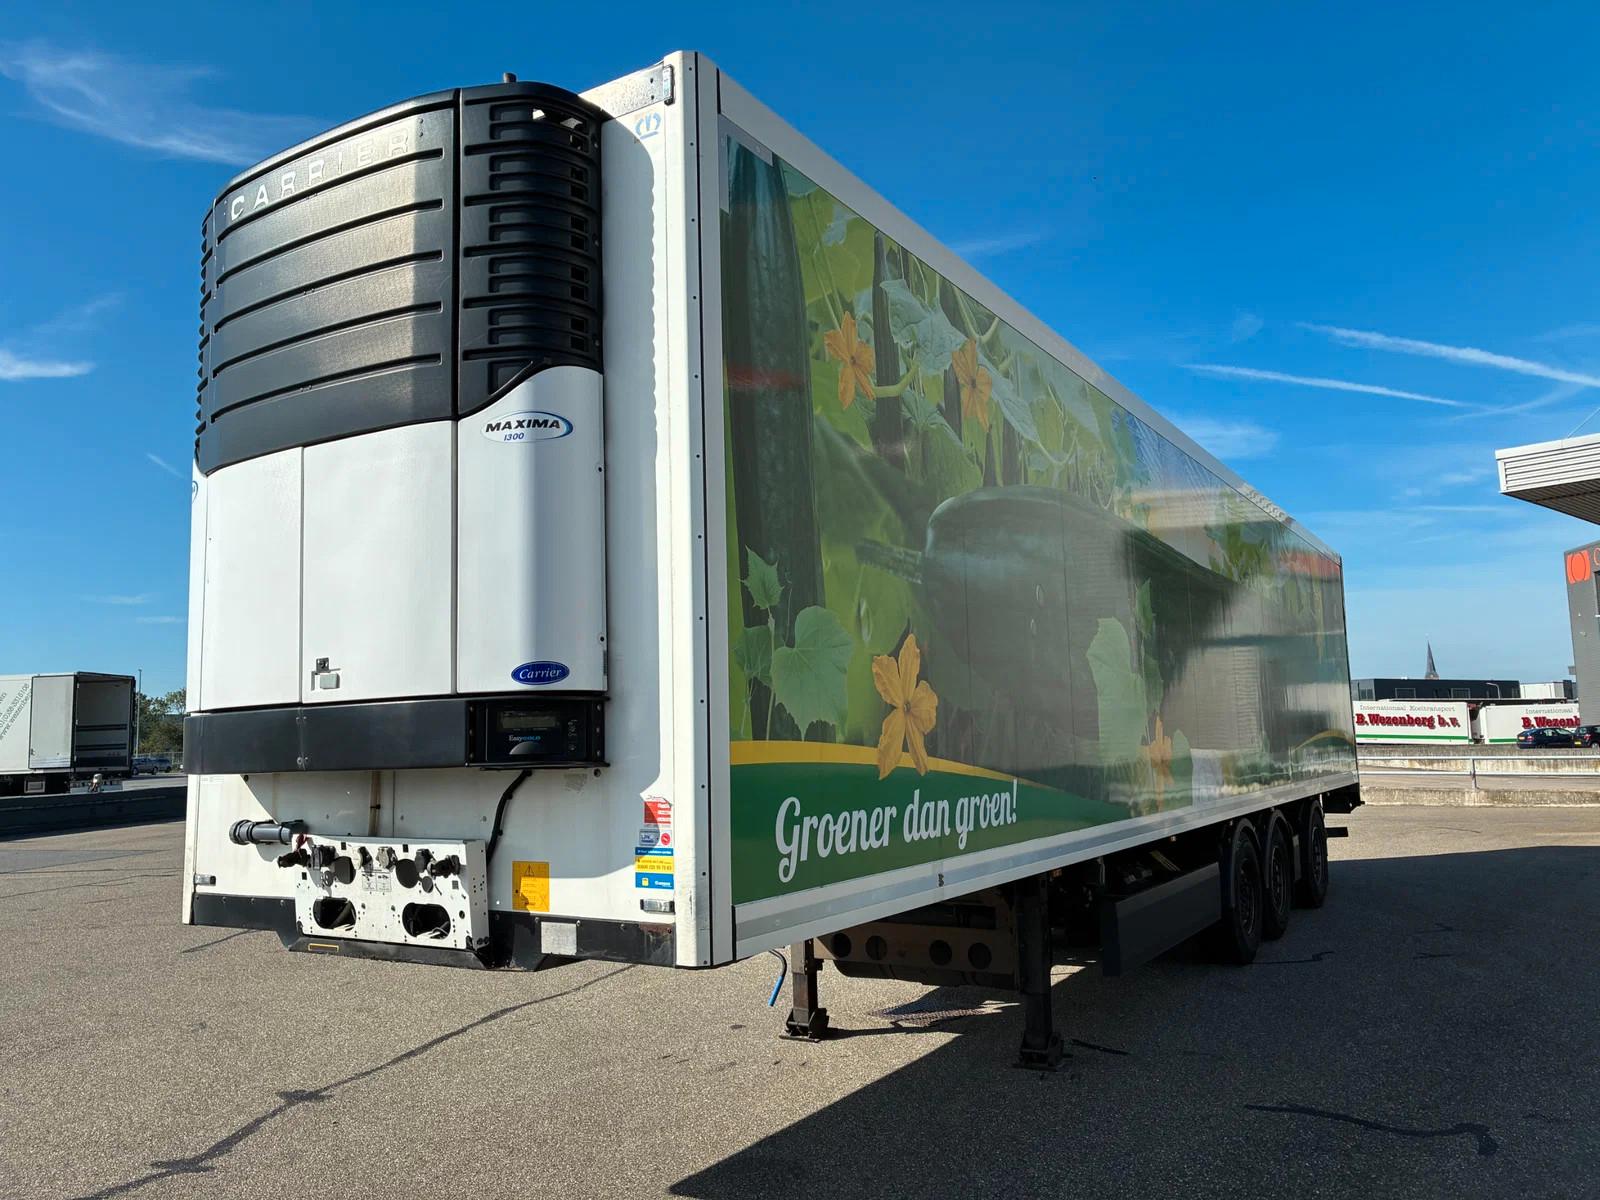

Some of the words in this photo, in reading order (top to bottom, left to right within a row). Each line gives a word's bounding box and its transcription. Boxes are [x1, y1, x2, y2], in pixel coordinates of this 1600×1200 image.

[231, 128, 408, 220] CARRIER
[486, 419, 560, 432] MAXIMA
[504, 433, 525, 441] 1300
[520, 668, 561, 679] Carrier
[776, 797, 897, 883] Groener
[903, 789, 950, 843] dan
[955, 779, 1017, 850] groen!
